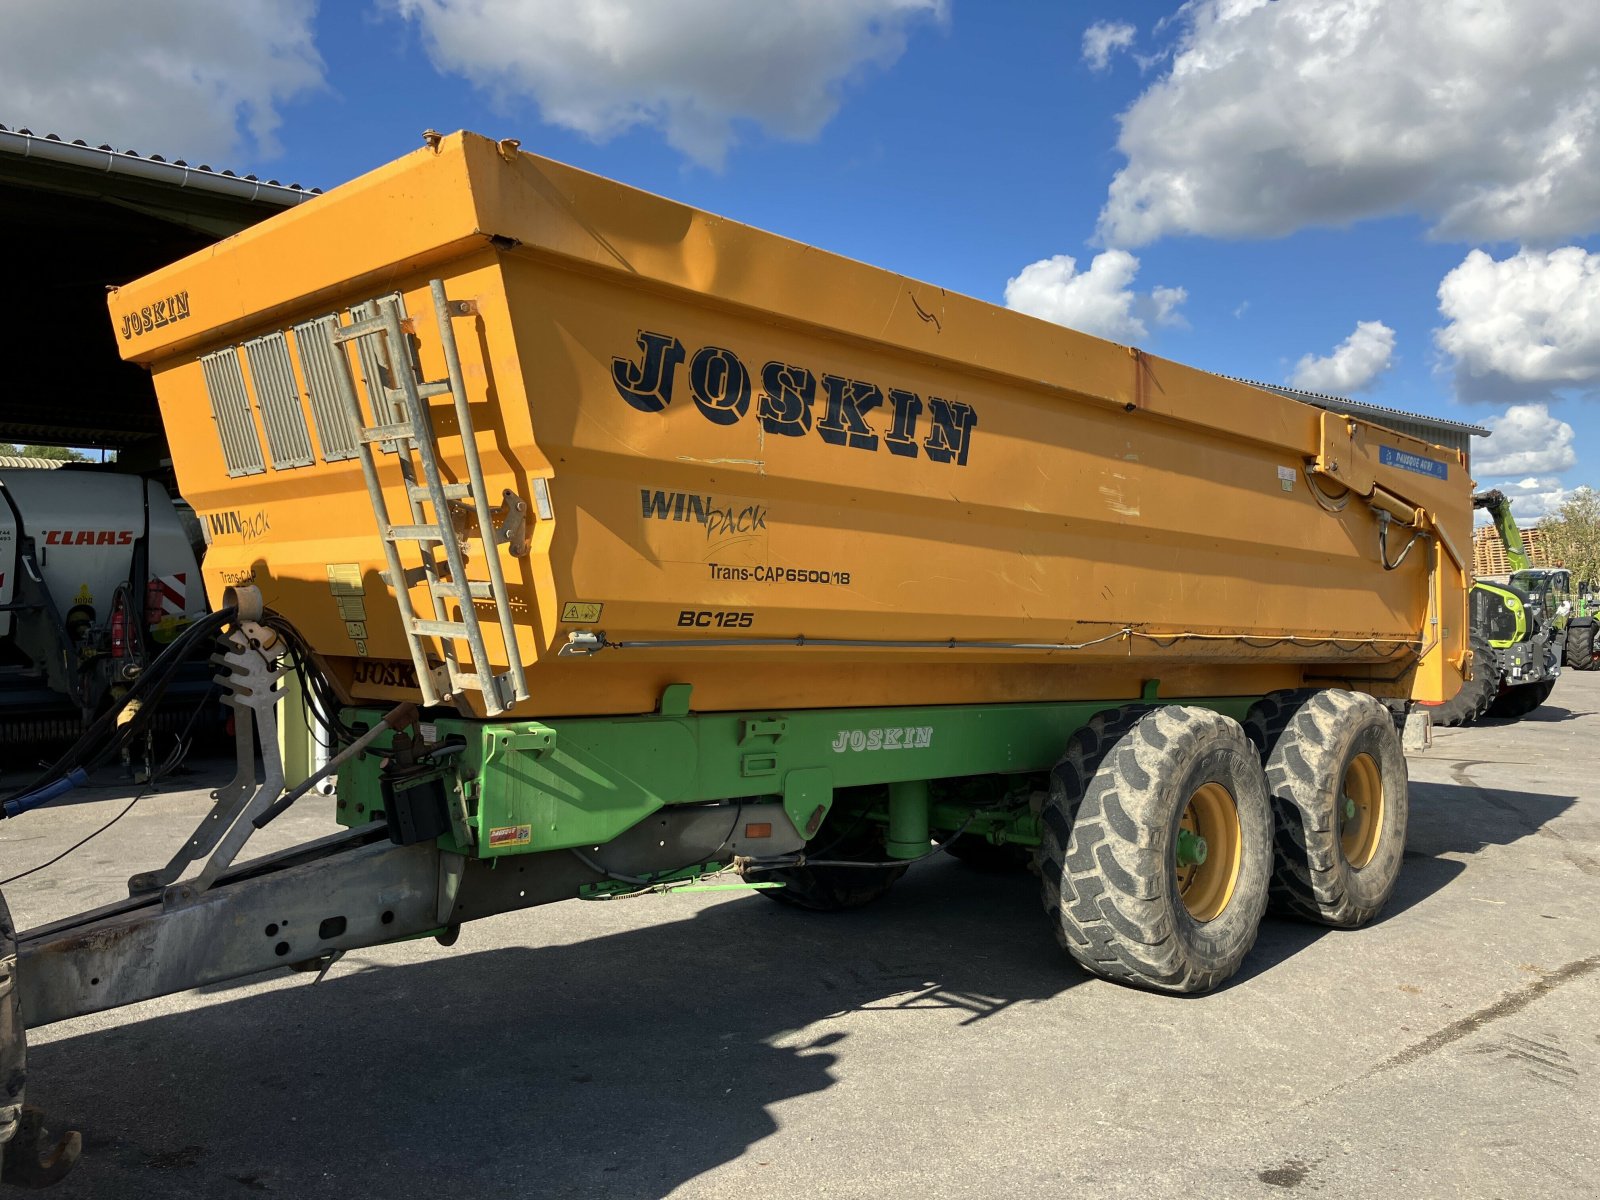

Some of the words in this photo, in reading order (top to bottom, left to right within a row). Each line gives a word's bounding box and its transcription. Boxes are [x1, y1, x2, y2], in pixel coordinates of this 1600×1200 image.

[121, 290, 191, 340] JOSKIN
[611, 328, 978, 467] JOSKIN
[46, 530, 133, 545] CLAAS
[219, 569, 256, 584] Trans-CAP
[355, 661, 421, 689] JOSK
[832, 726, 934, 753] JOSKIN
